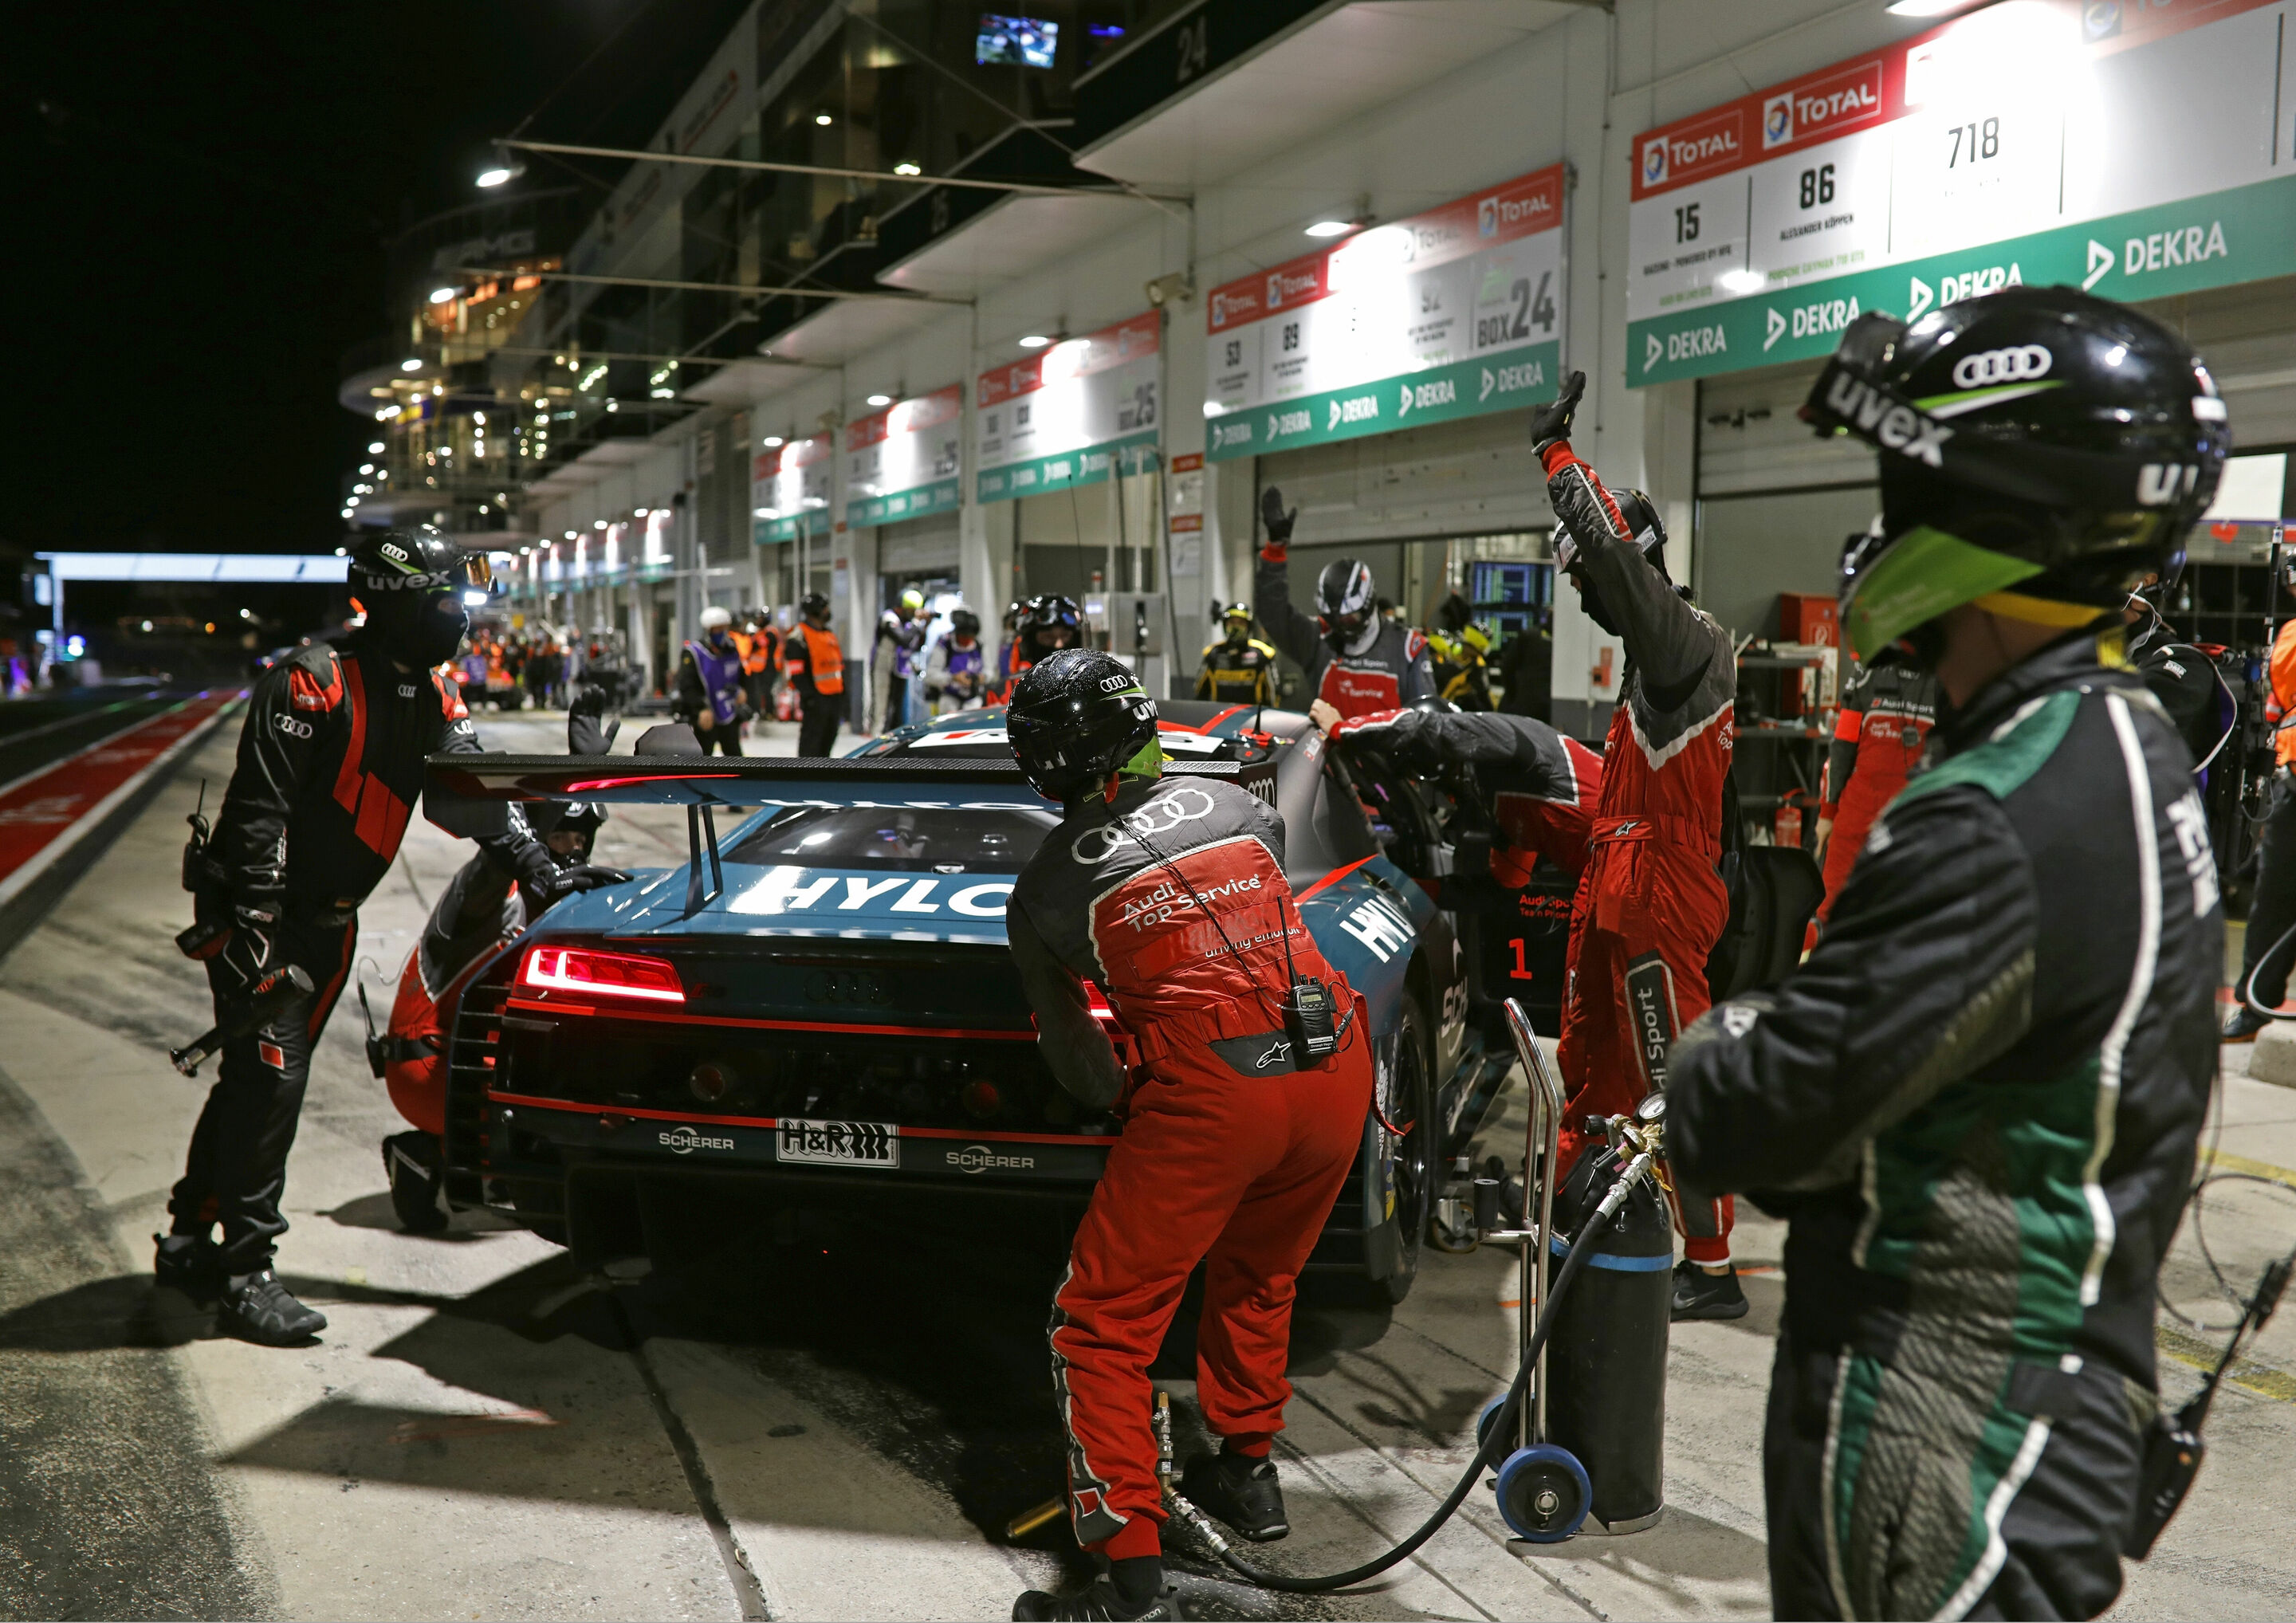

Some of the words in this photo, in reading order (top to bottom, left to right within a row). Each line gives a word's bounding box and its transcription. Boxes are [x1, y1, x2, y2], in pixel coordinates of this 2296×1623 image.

[1796, 83, 1877, 125] TOTAL
[1671, 130, 1738, 166] TOTAL
[1948, 116, 1999, 169] 718
[1799, 163, 1836, 210] 86
[1500, 194, 1551, 222] TOTAL
[1676, 202, 1700, 244] 15
[2125, 221, 2227, 276] DEKRA
[1940, 262, 2024, 308] DEKRA
[1512, 270, 1555, 339] 24
[1792, 296, 1860, 340] DEKRA
[1477, 312, 1511, 349] BOX
[1668, 324, 1727, 362] DEKRA
[1415, 379, 1457, 410] DEKRA
[1498, 361, 1544, 392] DEKRA
[1342, 395, 1379, 423] DEKRA
[1826, 370, 1956, 468] uvex
[367, 570, 451, 591] uvex
[1132, 699, 1158, 721] uv
[1123, 882, 1176, 921] Audi
[1127, 904, 1173, 933] Top
[1177, 878, 1261, 910] Service
[1508, 937, 1532, 980] 1
[1637, 988, 1665, 1060] Sport
[1651, 1067, 1667, 1090] di
[659, 1133, 734, 1149] SCHERER
[784, 1120, 850, 1157] H&R
[946, 1152, 1034, 1169] SCHERER
